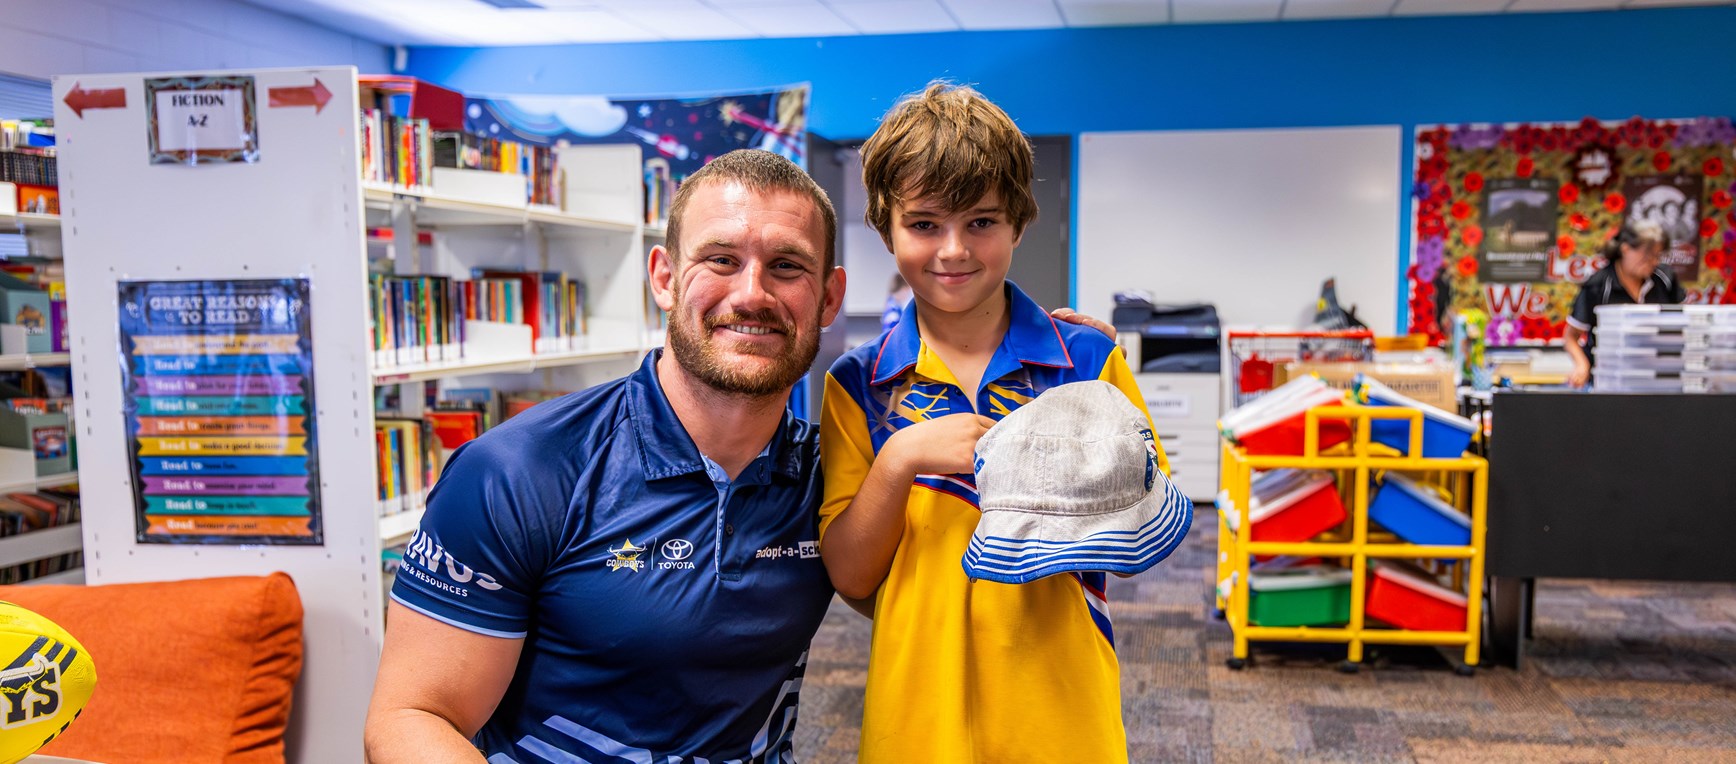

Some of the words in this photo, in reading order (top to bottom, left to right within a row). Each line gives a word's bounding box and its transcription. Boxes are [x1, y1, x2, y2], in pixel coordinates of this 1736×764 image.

[172, 94, 224, 106] FICTION
[150, 296, 204, 311] GREAT
[1486, 284, 1549, 317] We
[178, 311, 201, 325] TO
[205, 310, 250, 325] READ
[154, 360, 180, 371] Read
[155, 380, 182, 391] Read
[156, 400, 183, 411] Read
[157, 420, 184, 431] Read
[187, 420, 198, 431] to
[159, 440, 185, 450] Read
[188, 440, 200, 450] to
[161, 460, 188, 471] Read
[191, 460, 203, 471] to
[163, 479, 190, 490] Read
[193, 479, 205, 490] to
[165, 499, 193, 511] Read
[195, 499, 207, 511] to
[166, 519, 194, 530] Read
[606, 558, 645, 569] COWBOYS
[658, 561, 695, 570] TOYOTA
[415, 569, 468, 597] RESOURCES
